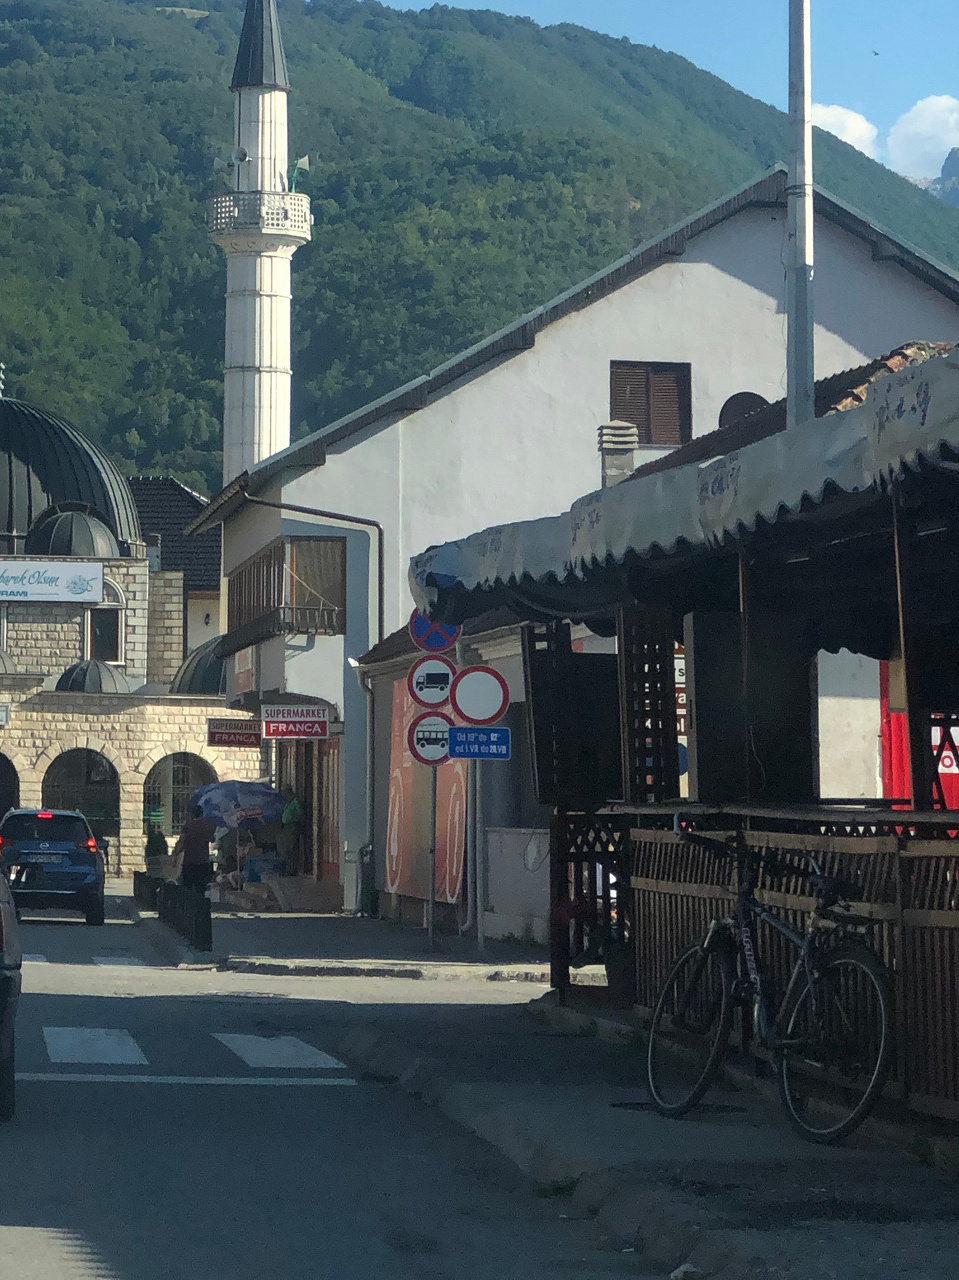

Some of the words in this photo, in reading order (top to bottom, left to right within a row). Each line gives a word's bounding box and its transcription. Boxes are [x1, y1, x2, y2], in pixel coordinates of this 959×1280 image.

[28, 569, 59, 587] Olsun
[265, 708, 326, 718] SUPERMARKET
[210, 722, 261, 731] SUPERMARKET
[270, 723, 321, 733] FRANCA
[215, 734, 256, 743] FRANCA
